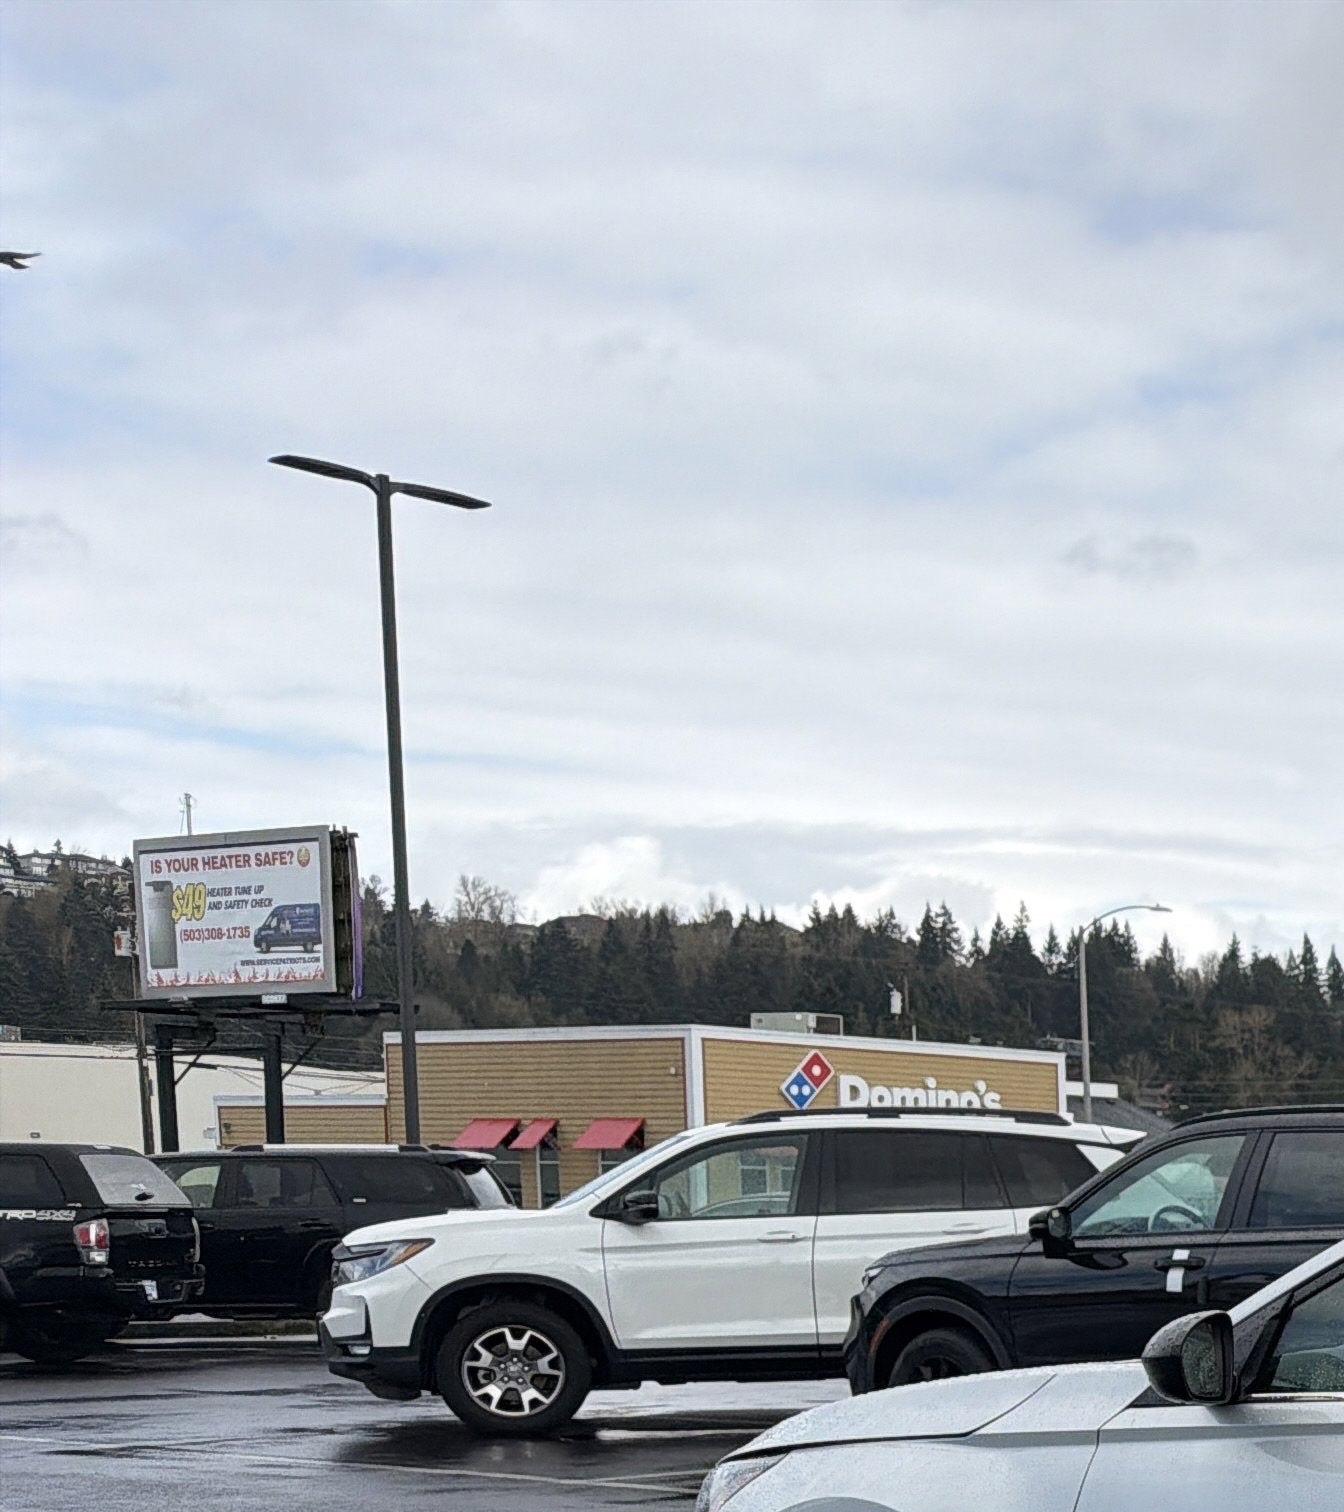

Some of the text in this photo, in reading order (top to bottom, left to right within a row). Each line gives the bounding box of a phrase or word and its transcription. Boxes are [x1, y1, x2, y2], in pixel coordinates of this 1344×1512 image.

[150, 851, 294, 874] IS YOUR HEATER SAFE?
[172, 882, 206, 922] $49
[207, 887, 232, 898] HEATER
[254, 885, 264, 895] UP
[207, 898, 273, 911] AND SAFETY CHECK
[838, 1074, 1001, 1109] Domino's
